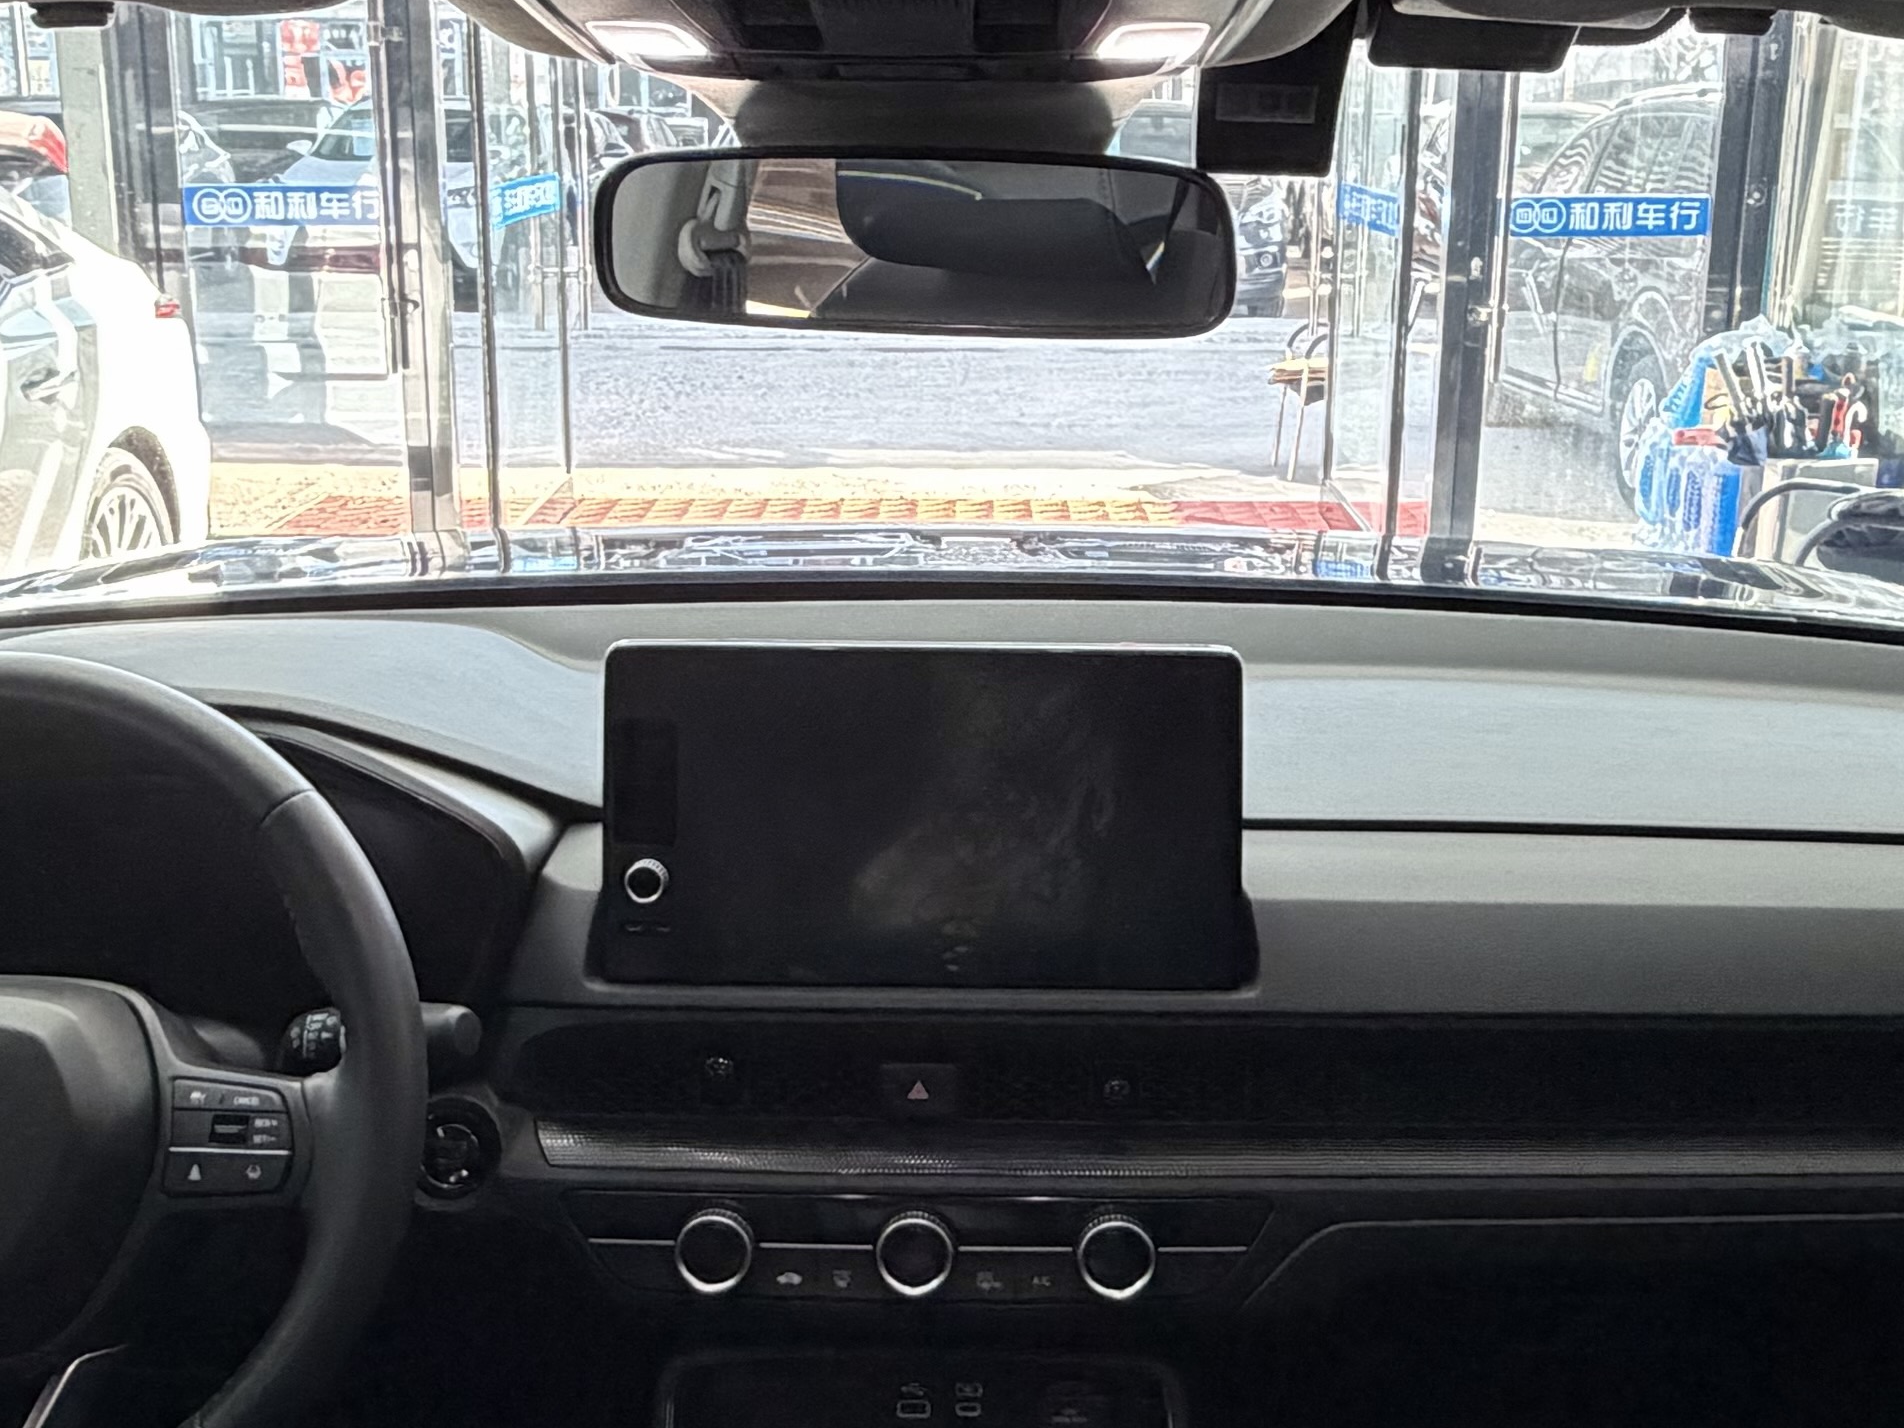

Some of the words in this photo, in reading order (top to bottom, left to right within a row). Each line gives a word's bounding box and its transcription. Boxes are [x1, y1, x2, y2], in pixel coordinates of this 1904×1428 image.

[253, 190, 380, 220] 和利车行
[1568, 201, 1701, 231] 和利车行
